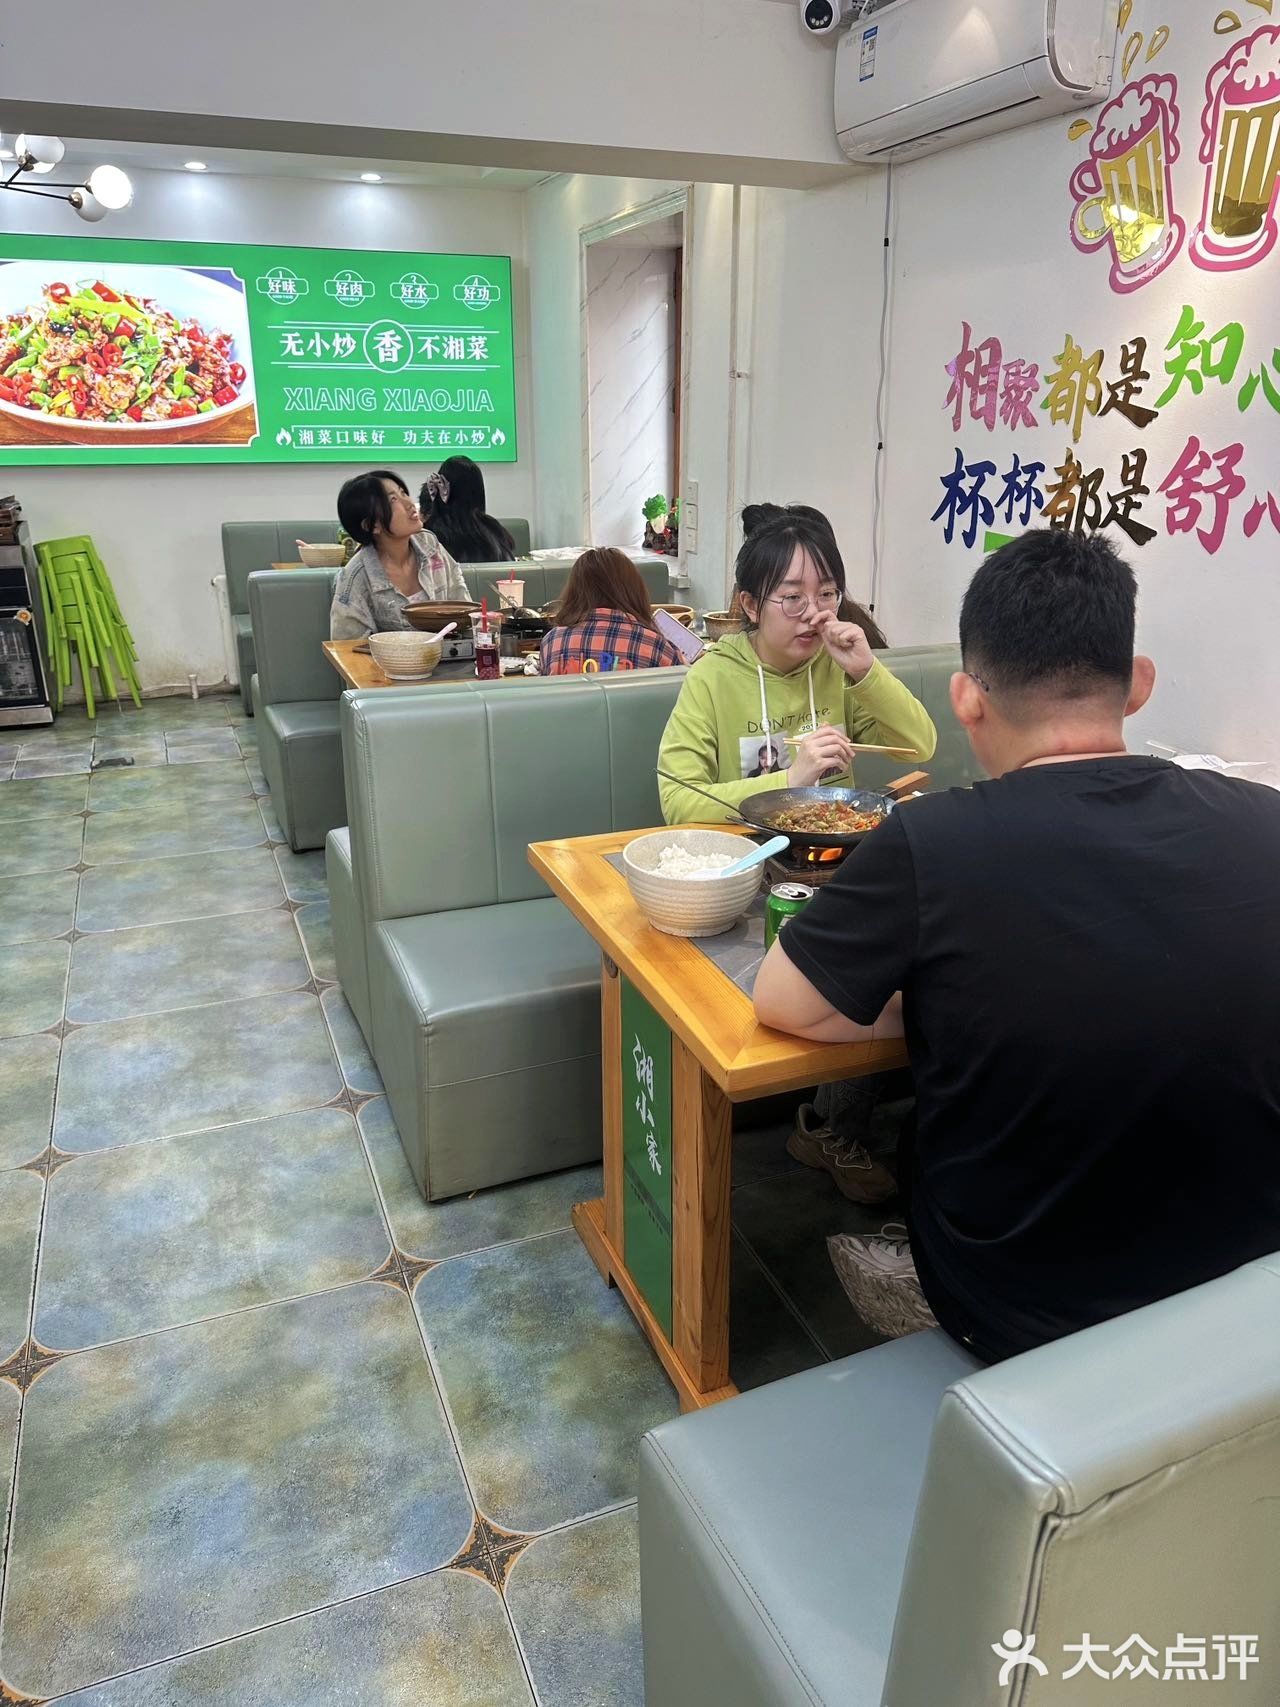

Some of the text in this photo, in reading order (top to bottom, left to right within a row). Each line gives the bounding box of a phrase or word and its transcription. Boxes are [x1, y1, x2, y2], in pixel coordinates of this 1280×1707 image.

[268, 279, 297, 294] 好味
[335, 281, 363, 296] 好肉
[401, 284, 428, 299] 好水
[464, 286, 490, 301] 好功
[279, 329, 489, 364] 无小炒 香 不湘菜
[283, 386, 495, 413] XIANG XIAOJIA
[298, 429, 486, 446] 湘菜口味好 功夫在小炒
